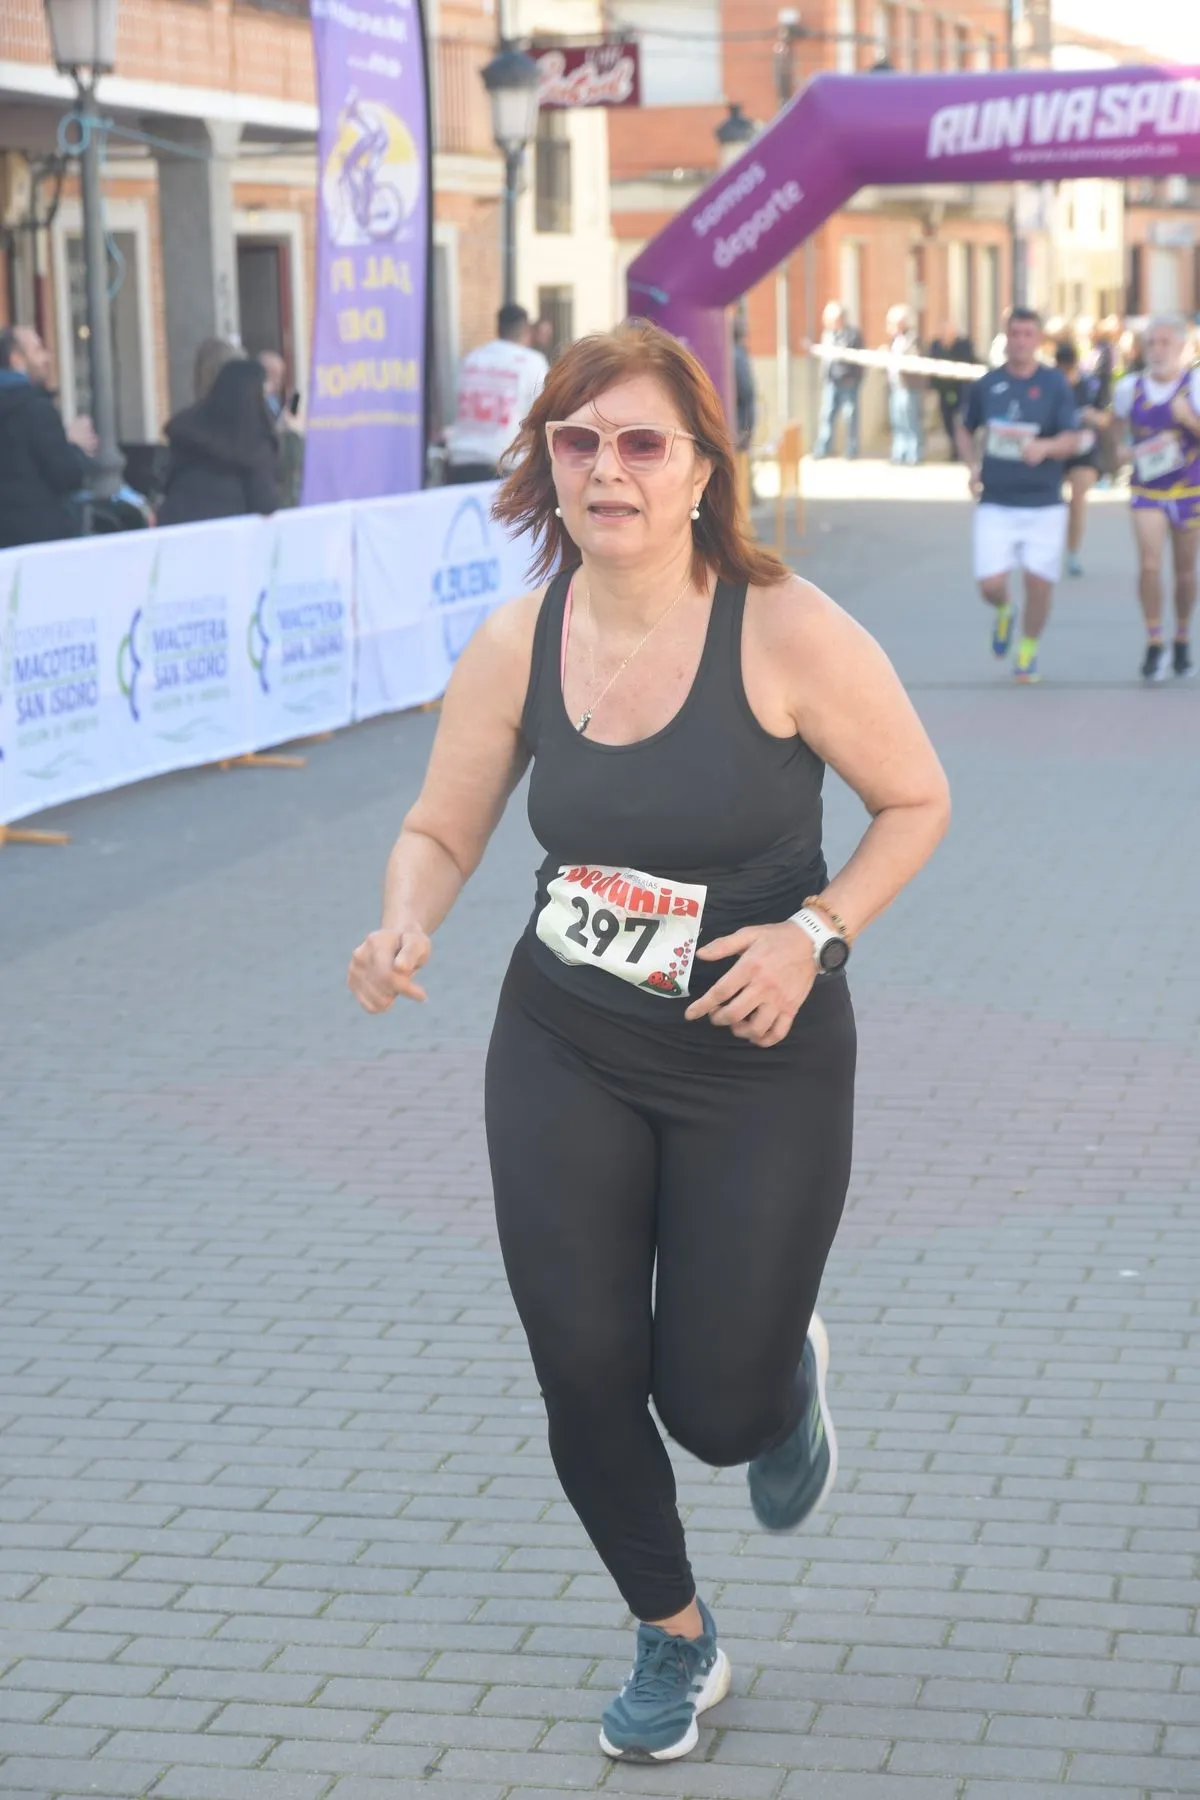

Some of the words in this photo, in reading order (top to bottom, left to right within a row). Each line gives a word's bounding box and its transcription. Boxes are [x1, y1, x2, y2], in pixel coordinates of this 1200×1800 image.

[692, 161, 766, 237] somos
[713, 180, 805, 268] deporte
[153, 618, 228, 655] MACOTERA
[14, 642, 97, 684] MACOTERA
[154, 663, 180, 692] SAN
[183, 651, 228, 685] ISIDRO
[16, 691, 46, 726] SAN
[50, 678, 99, 716] ISIDRO
[564, 895, 661, 965] 297
